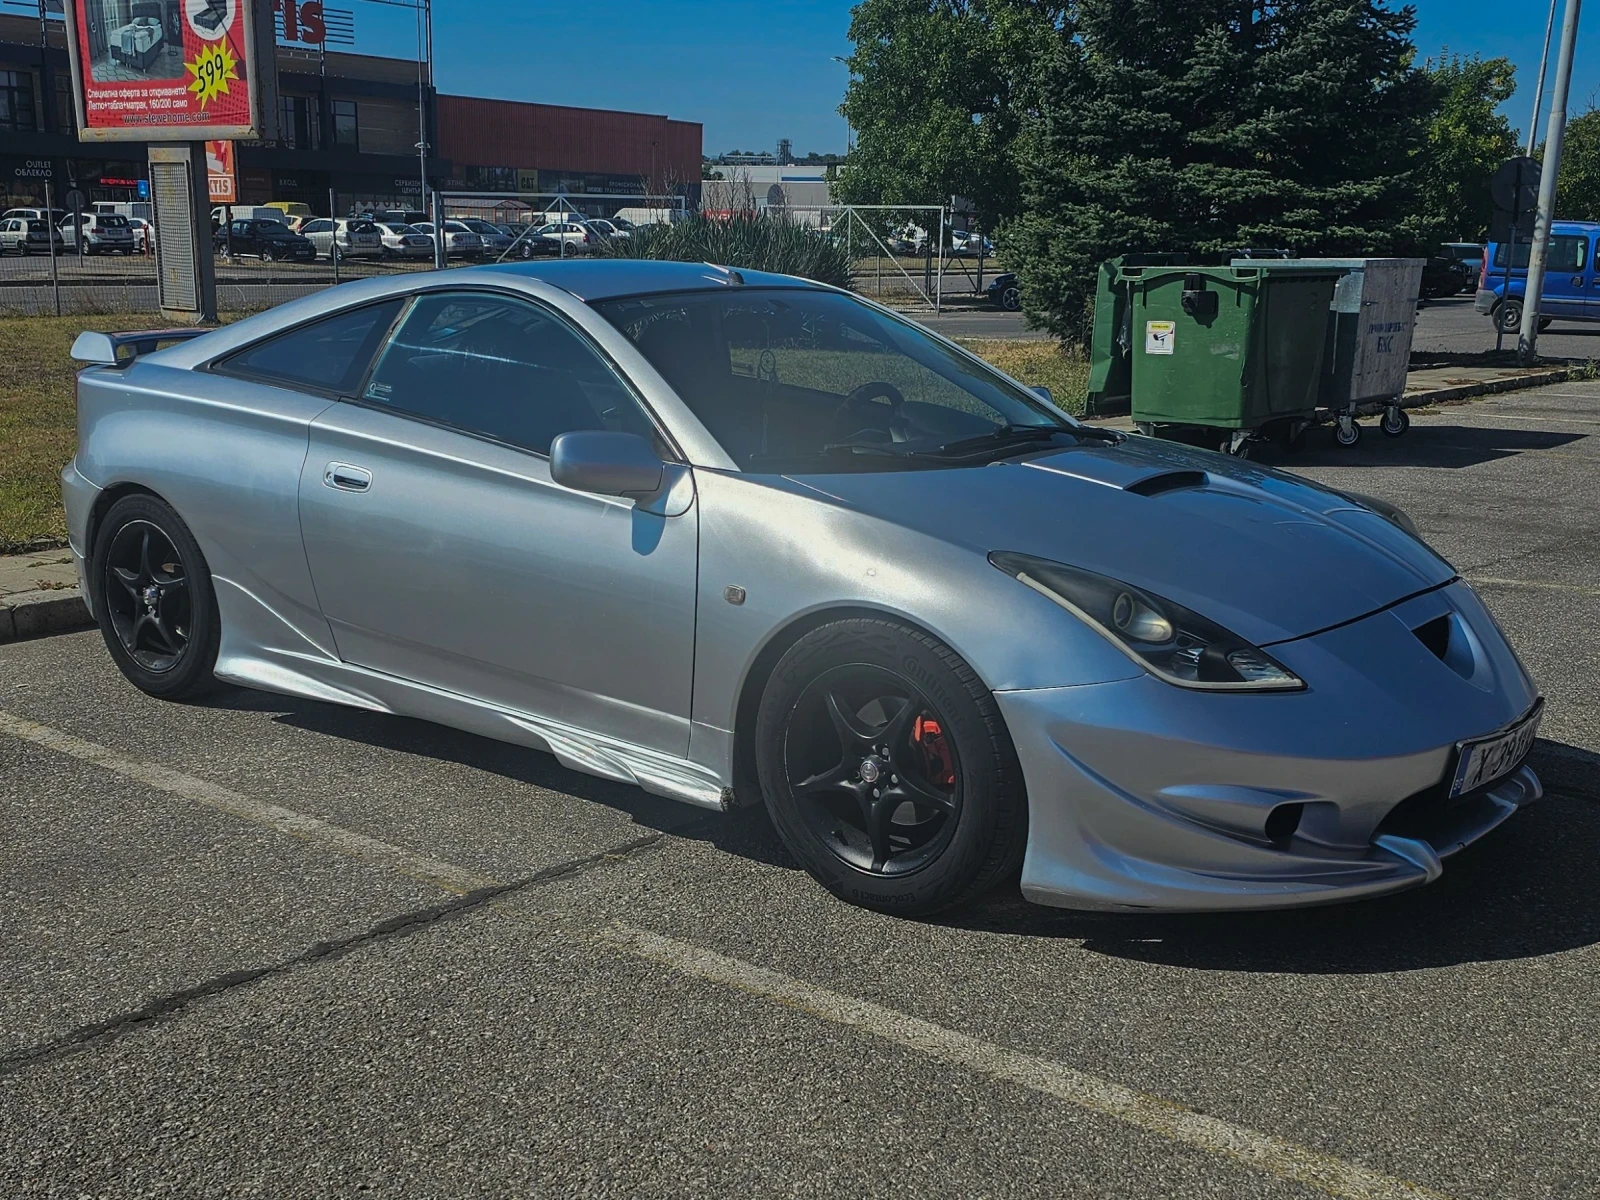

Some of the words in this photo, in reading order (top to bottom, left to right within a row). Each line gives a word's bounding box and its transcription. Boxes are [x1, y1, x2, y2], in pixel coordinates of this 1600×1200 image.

[273, 0, 326, 44] IS
[197, 53, 224, 93] 599
[87, 88, 118, 99] Специална
[119, 88, 140, 99] оферта
[141, 89, 148, 97] за
[149, 85, 187, 98] откриването!
[149, 99, 171, 109] 160/200
[172, 99, 188, 108] само
[123, 110, 210, 124] www.stewehome.com
[25, 160, 51, 169] OUTLET
[14, 168, 52, 177] ОБЛЕКЛО
[279, 178, 298, 187] ВХОД
[447, 179, 465, 187] STIHL
[521, 177, 534, 189] CAT
[401, 187, 421, 195] ЦЕНТЪР
[852, 889, 859, 898] 6
[860, 890, 917, 904] EcoContact
